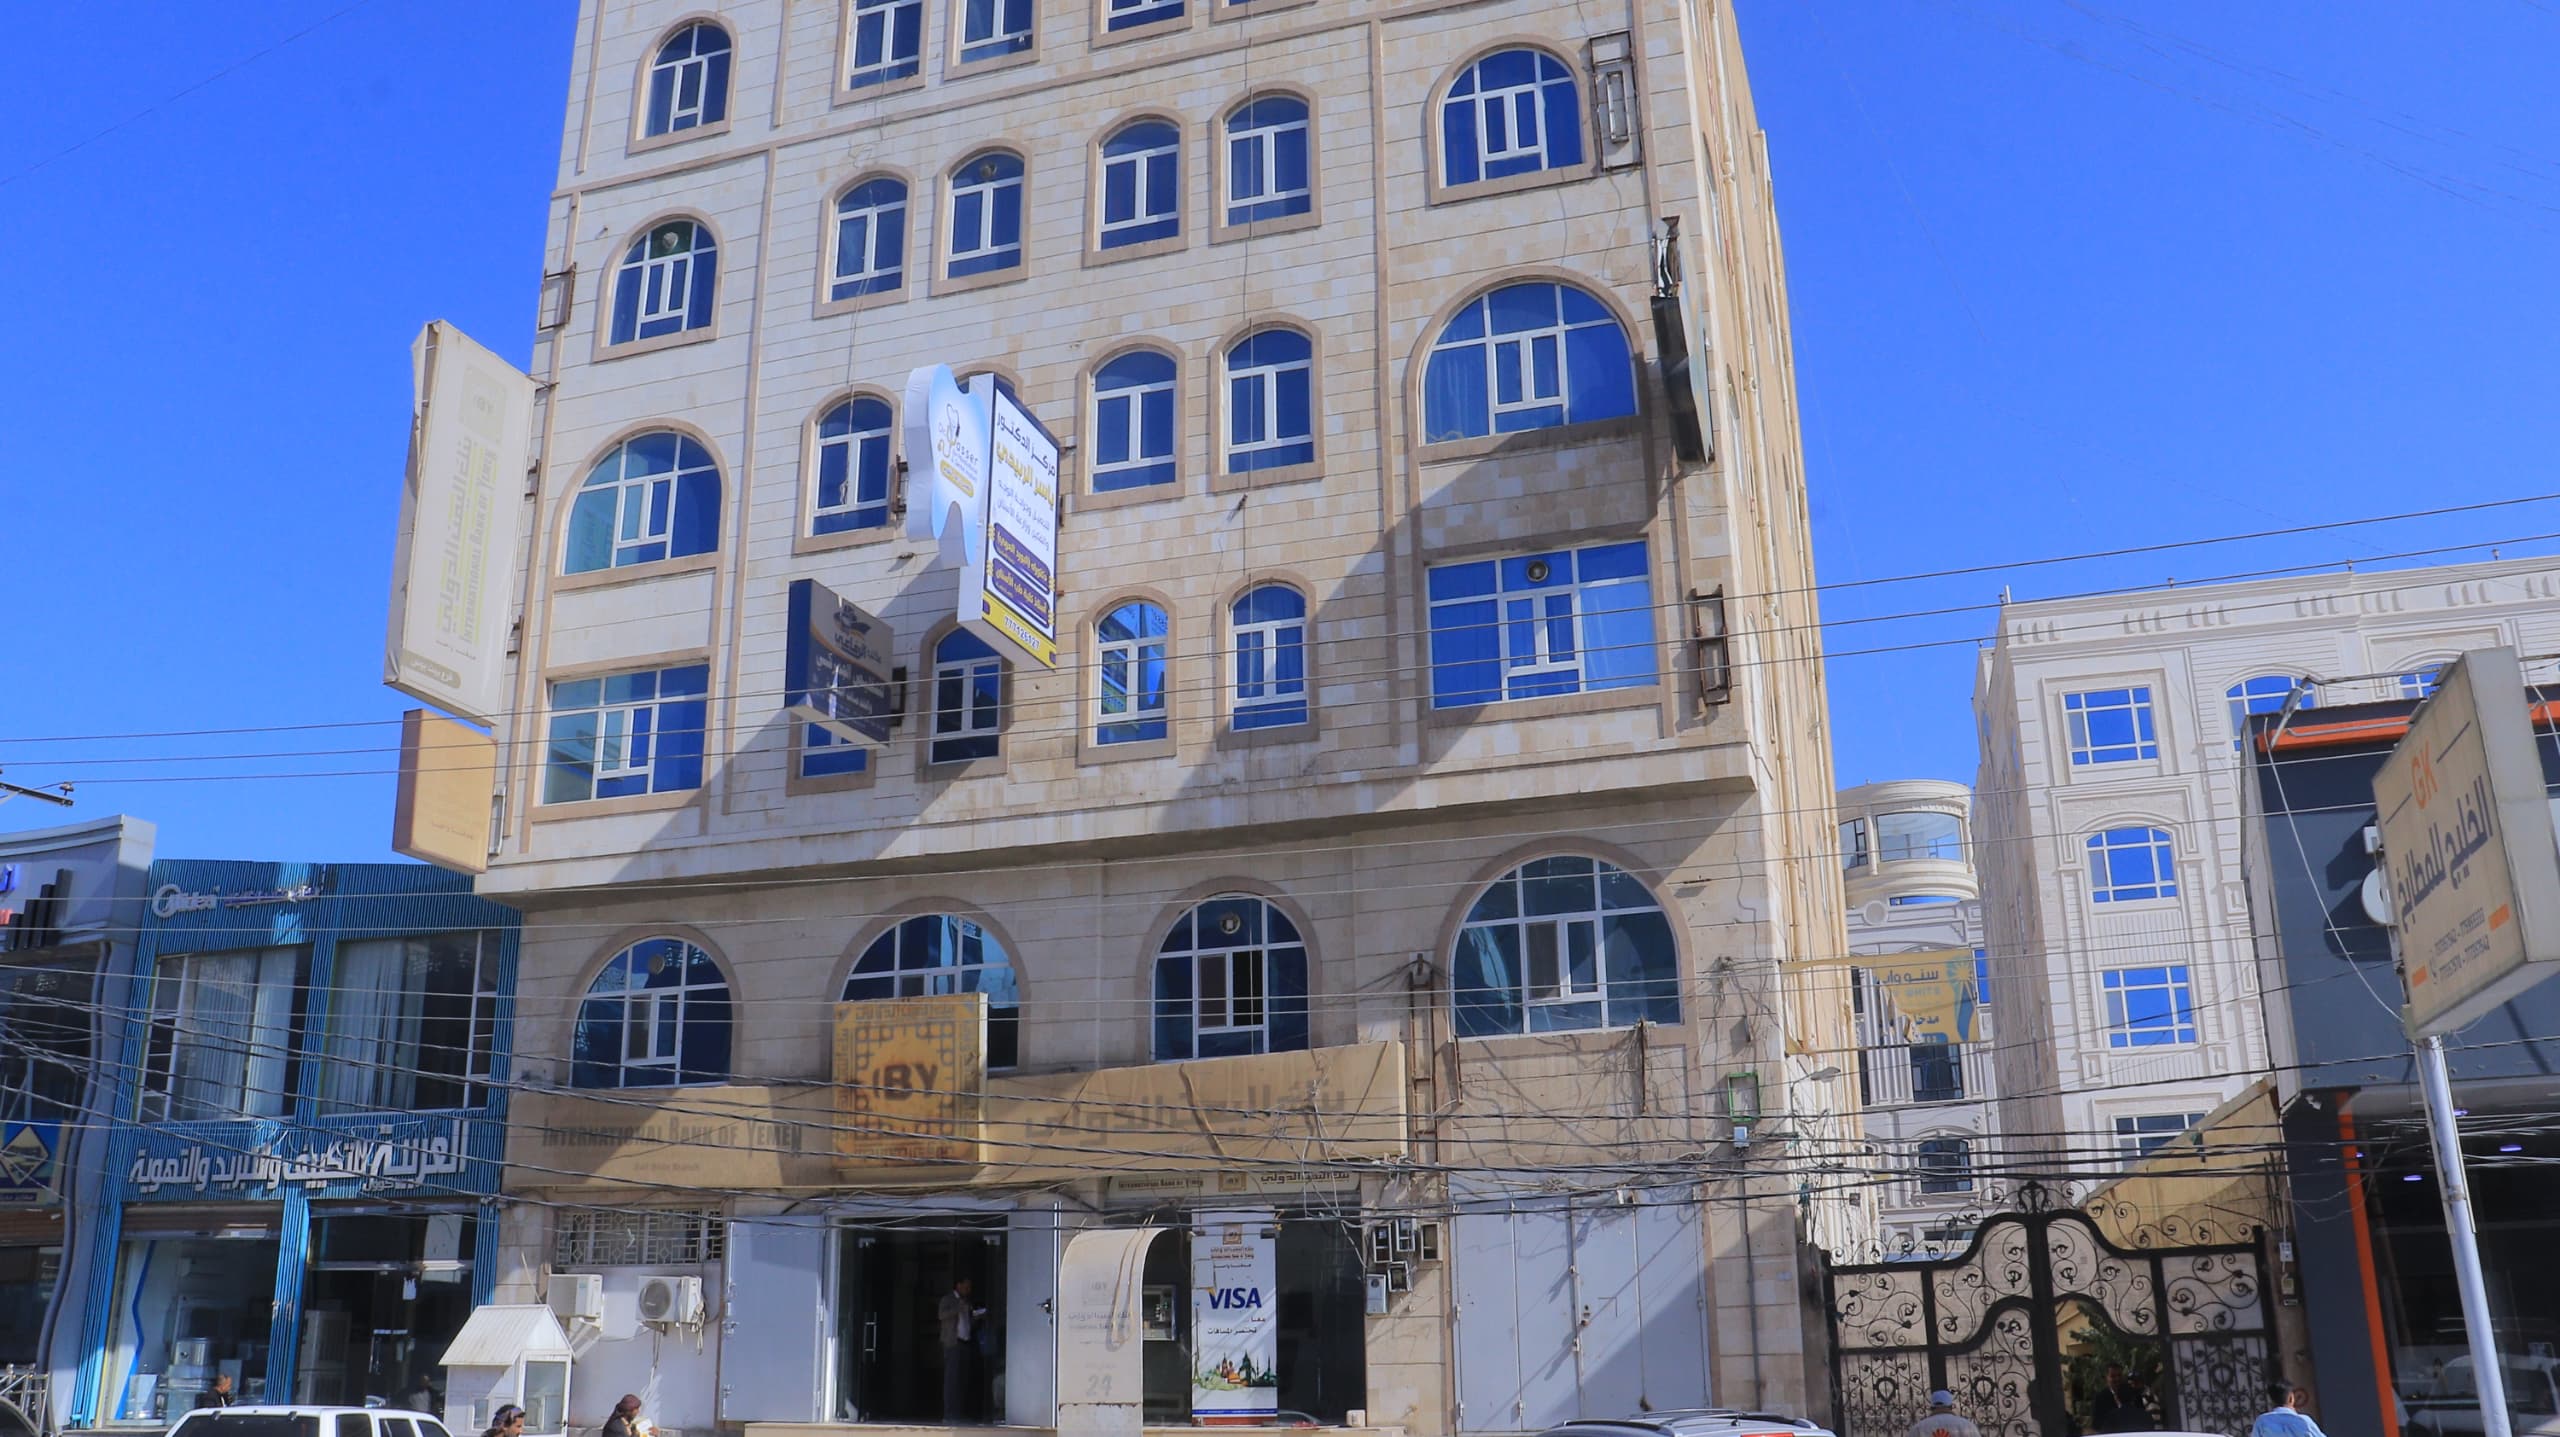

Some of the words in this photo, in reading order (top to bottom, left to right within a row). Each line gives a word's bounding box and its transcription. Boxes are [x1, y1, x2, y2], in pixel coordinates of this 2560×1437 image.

[2411, 740, 2438, 811] GK
[2443, 774, 2494, 891] الخليج
[872, 1063, 938, 1101] IBY
[370, 1120, 469, 1189] العربية
[541, 1118, 662, 1147] INTERNATIONAL
[669, 1116, 713, 1146] BANK
[718, 1127, 738, 1146] OF
[746, 1118, 803, 1158] YEMEN
[128, 1145, 210, 1193] والتهوية
[1208, 1287, 1262, 1310] VISA
